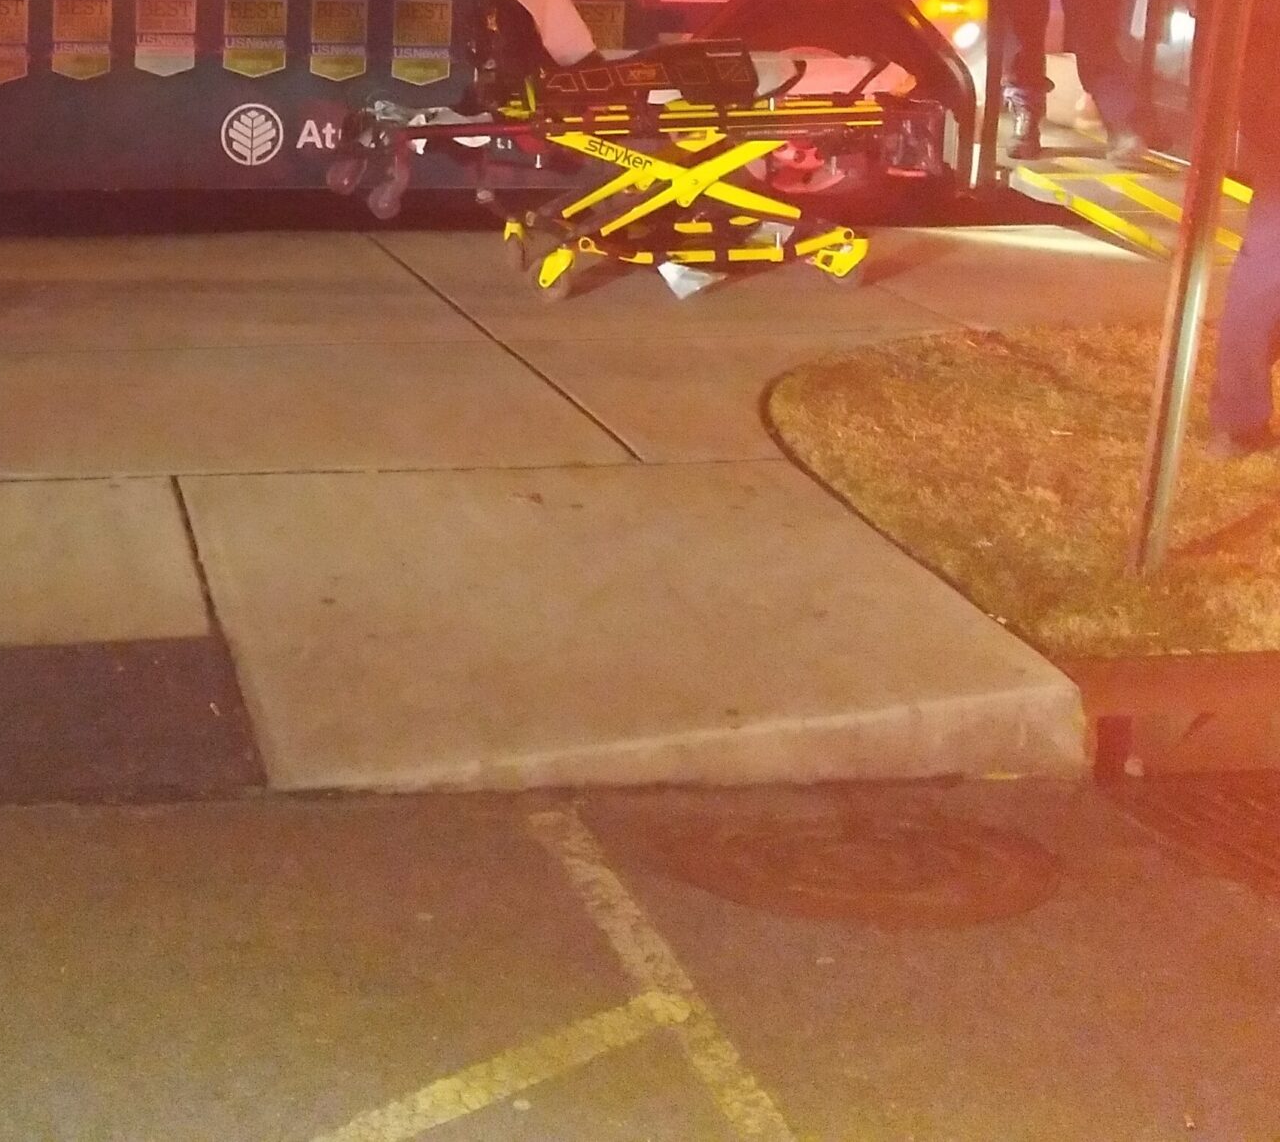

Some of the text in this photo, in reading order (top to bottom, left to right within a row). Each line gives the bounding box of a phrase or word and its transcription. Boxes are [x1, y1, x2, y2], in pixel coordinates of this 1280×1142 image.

[141, 0, 192, 18] BEST
[230, 1, 284, 19] BEST
[584, 139, 653, 171] stryker
